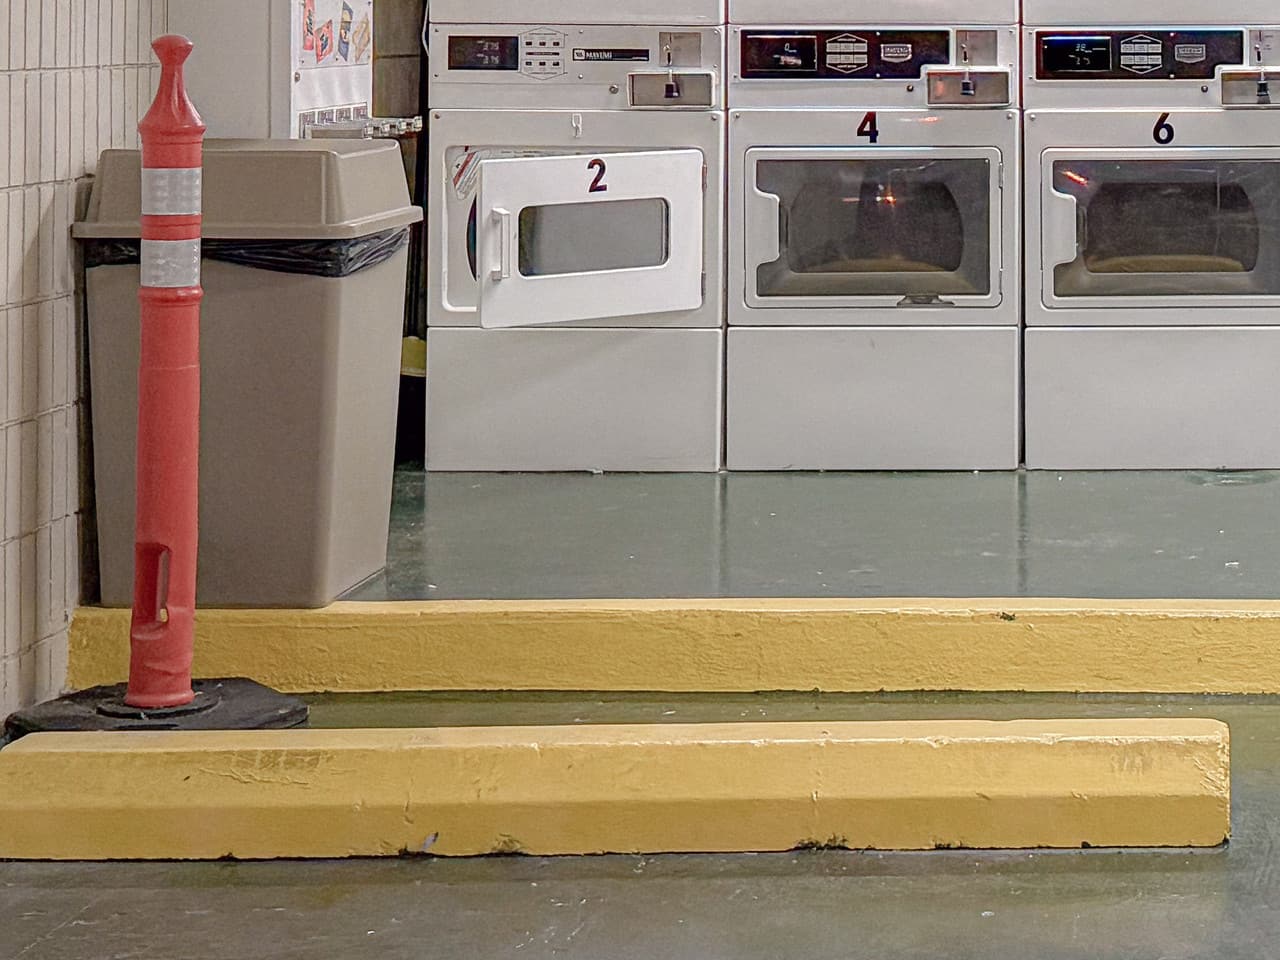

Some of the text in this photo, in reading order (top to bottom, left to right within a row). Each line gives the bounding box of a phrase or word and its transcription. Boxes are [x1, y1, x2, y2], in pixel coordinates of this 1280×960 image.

[857, 112, 879, 143] 4
[1152, 113, 1174, 144] 6
[587, 158, 608, 193] 2
